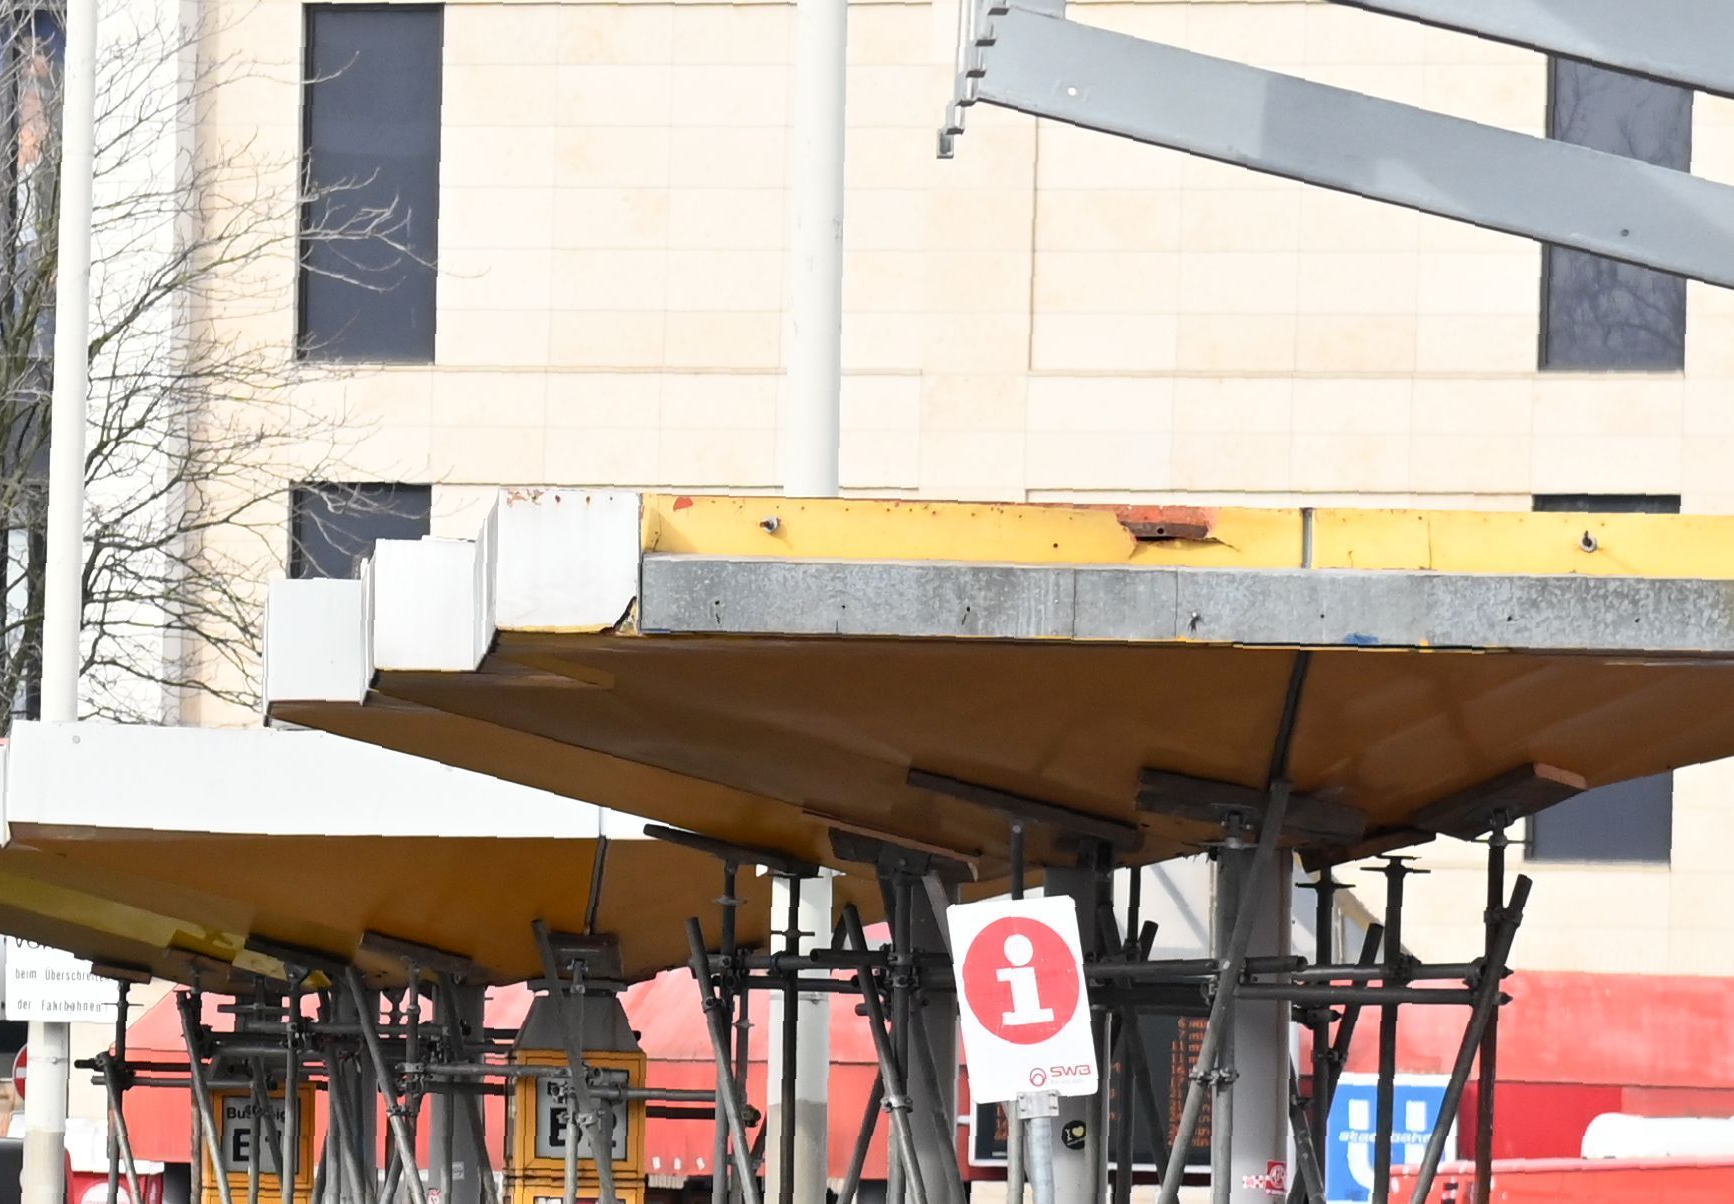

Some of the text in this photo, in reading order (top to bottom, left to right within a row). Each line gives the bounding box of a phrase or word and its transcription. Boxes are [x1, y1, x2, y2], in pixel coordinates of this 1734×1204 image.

[14, 967, 37, 980] beim
[17, 998, 32, 1010] der
[1050, 1064, 1092, 1078] SWB
